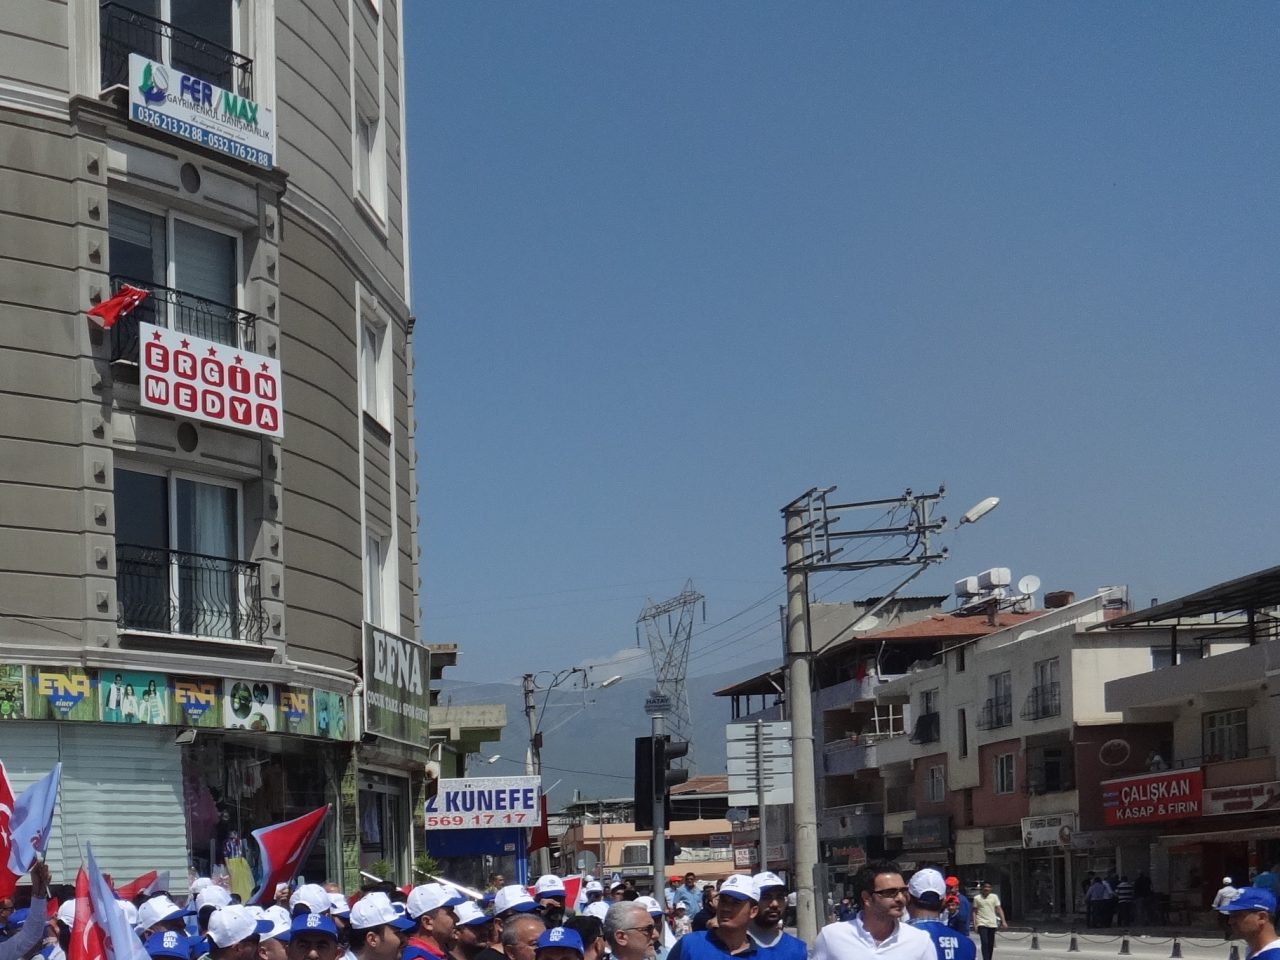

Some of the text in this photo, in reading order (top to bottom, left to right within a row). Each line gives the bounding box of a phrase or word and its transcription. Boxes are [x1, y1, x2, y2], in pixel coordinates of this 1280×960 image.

[138, 107, 160, 126] 0326
[162, 116, 178, 133] 213
[180, 123, 191, 138] 22
[192, 127, 202, 142] 88
[208, 134, 229, 152] 0532
[231, 142, 245, 158] 176
[246, 148, 257, 162] 22
[258, 152, 268, 166] 88
[150, 346, 273, 398] ERGİN
[148, 378, 274, 427] MEDYA
[372, 630, 423, 696] EFNA
[446, 784, 534, 812] KÜNEFE
[1121, 779, 1190, 807] ÇALIŞKAN
[428, 813, 527, 827] 569 17 17
[1116, 801, 1198, 820] KASAP & FIRIN
[938, 936, 958, 948] SEN
